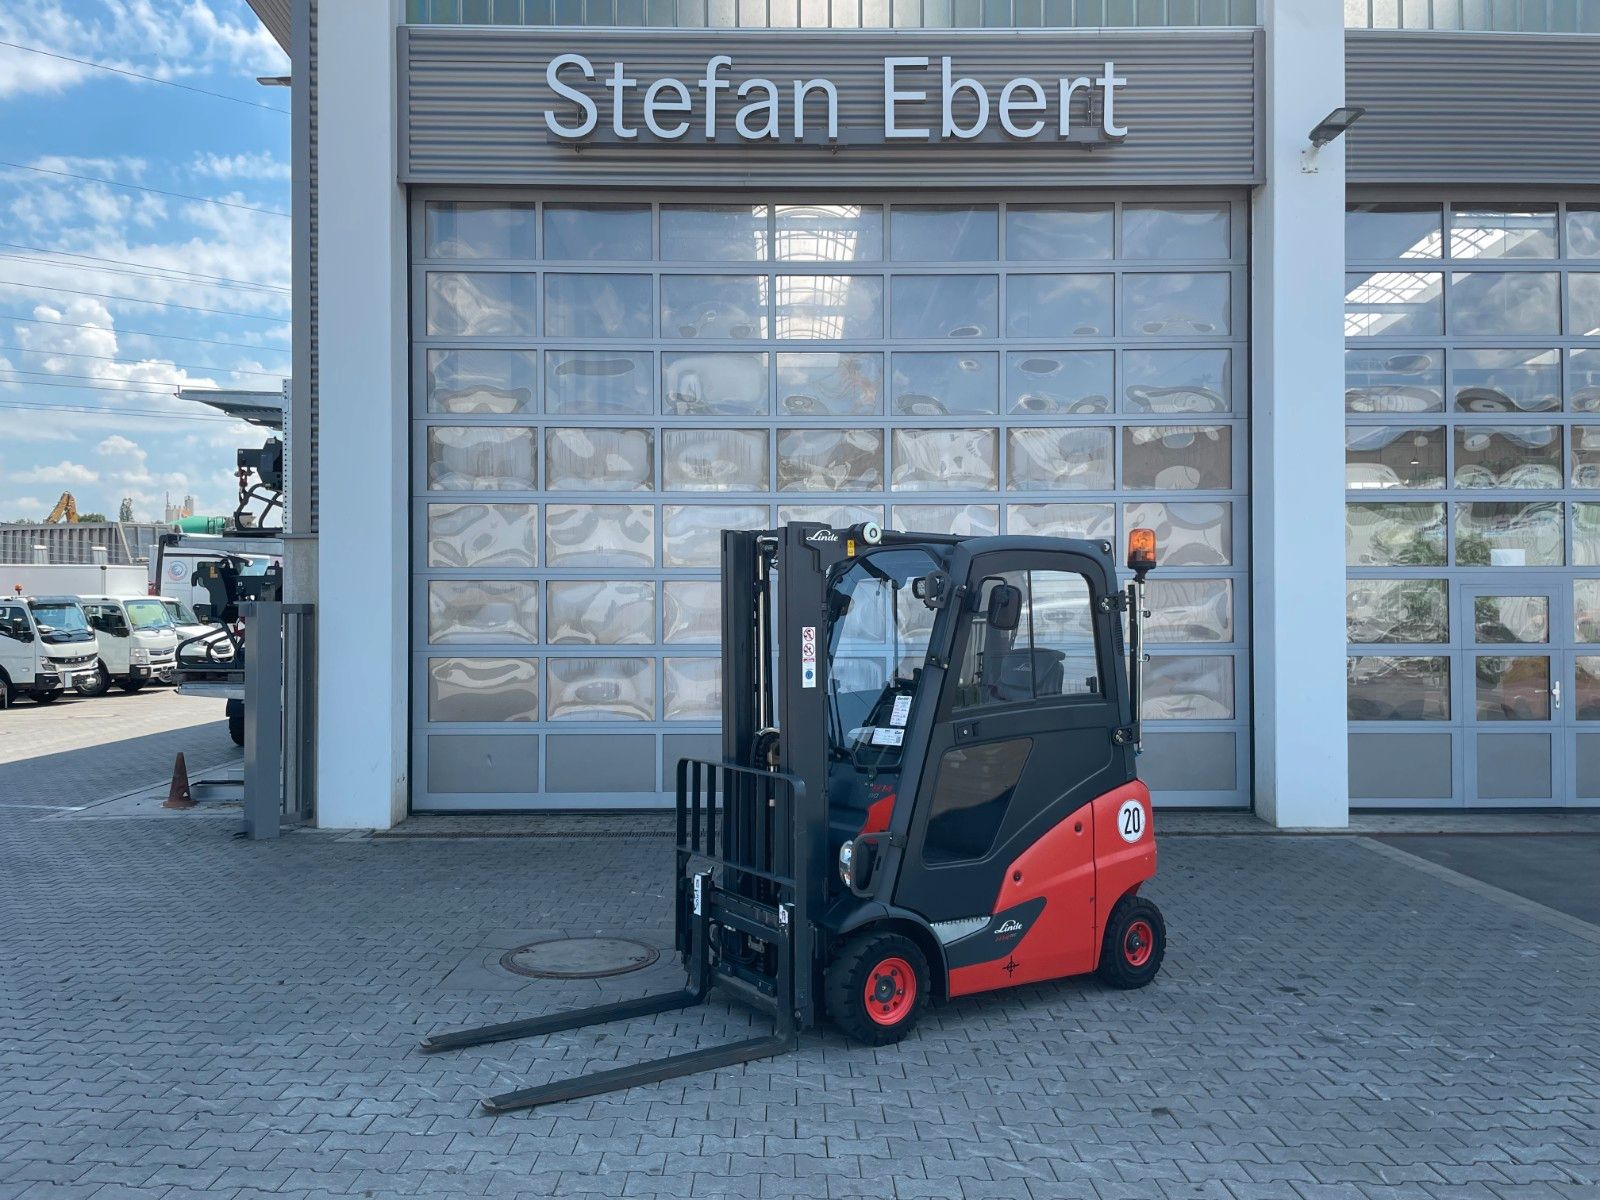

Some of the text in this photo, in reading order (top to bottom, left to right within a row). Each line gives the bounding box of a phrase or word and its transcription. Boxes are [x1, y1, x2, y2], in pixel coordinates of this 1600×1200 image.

[544, 53, 1128, 140] Stefan Ebert
[806, 529, 839, 542] Linde
[1123, 806, 1141, 835] 20
[994, 919, 1024, 934] Linde
